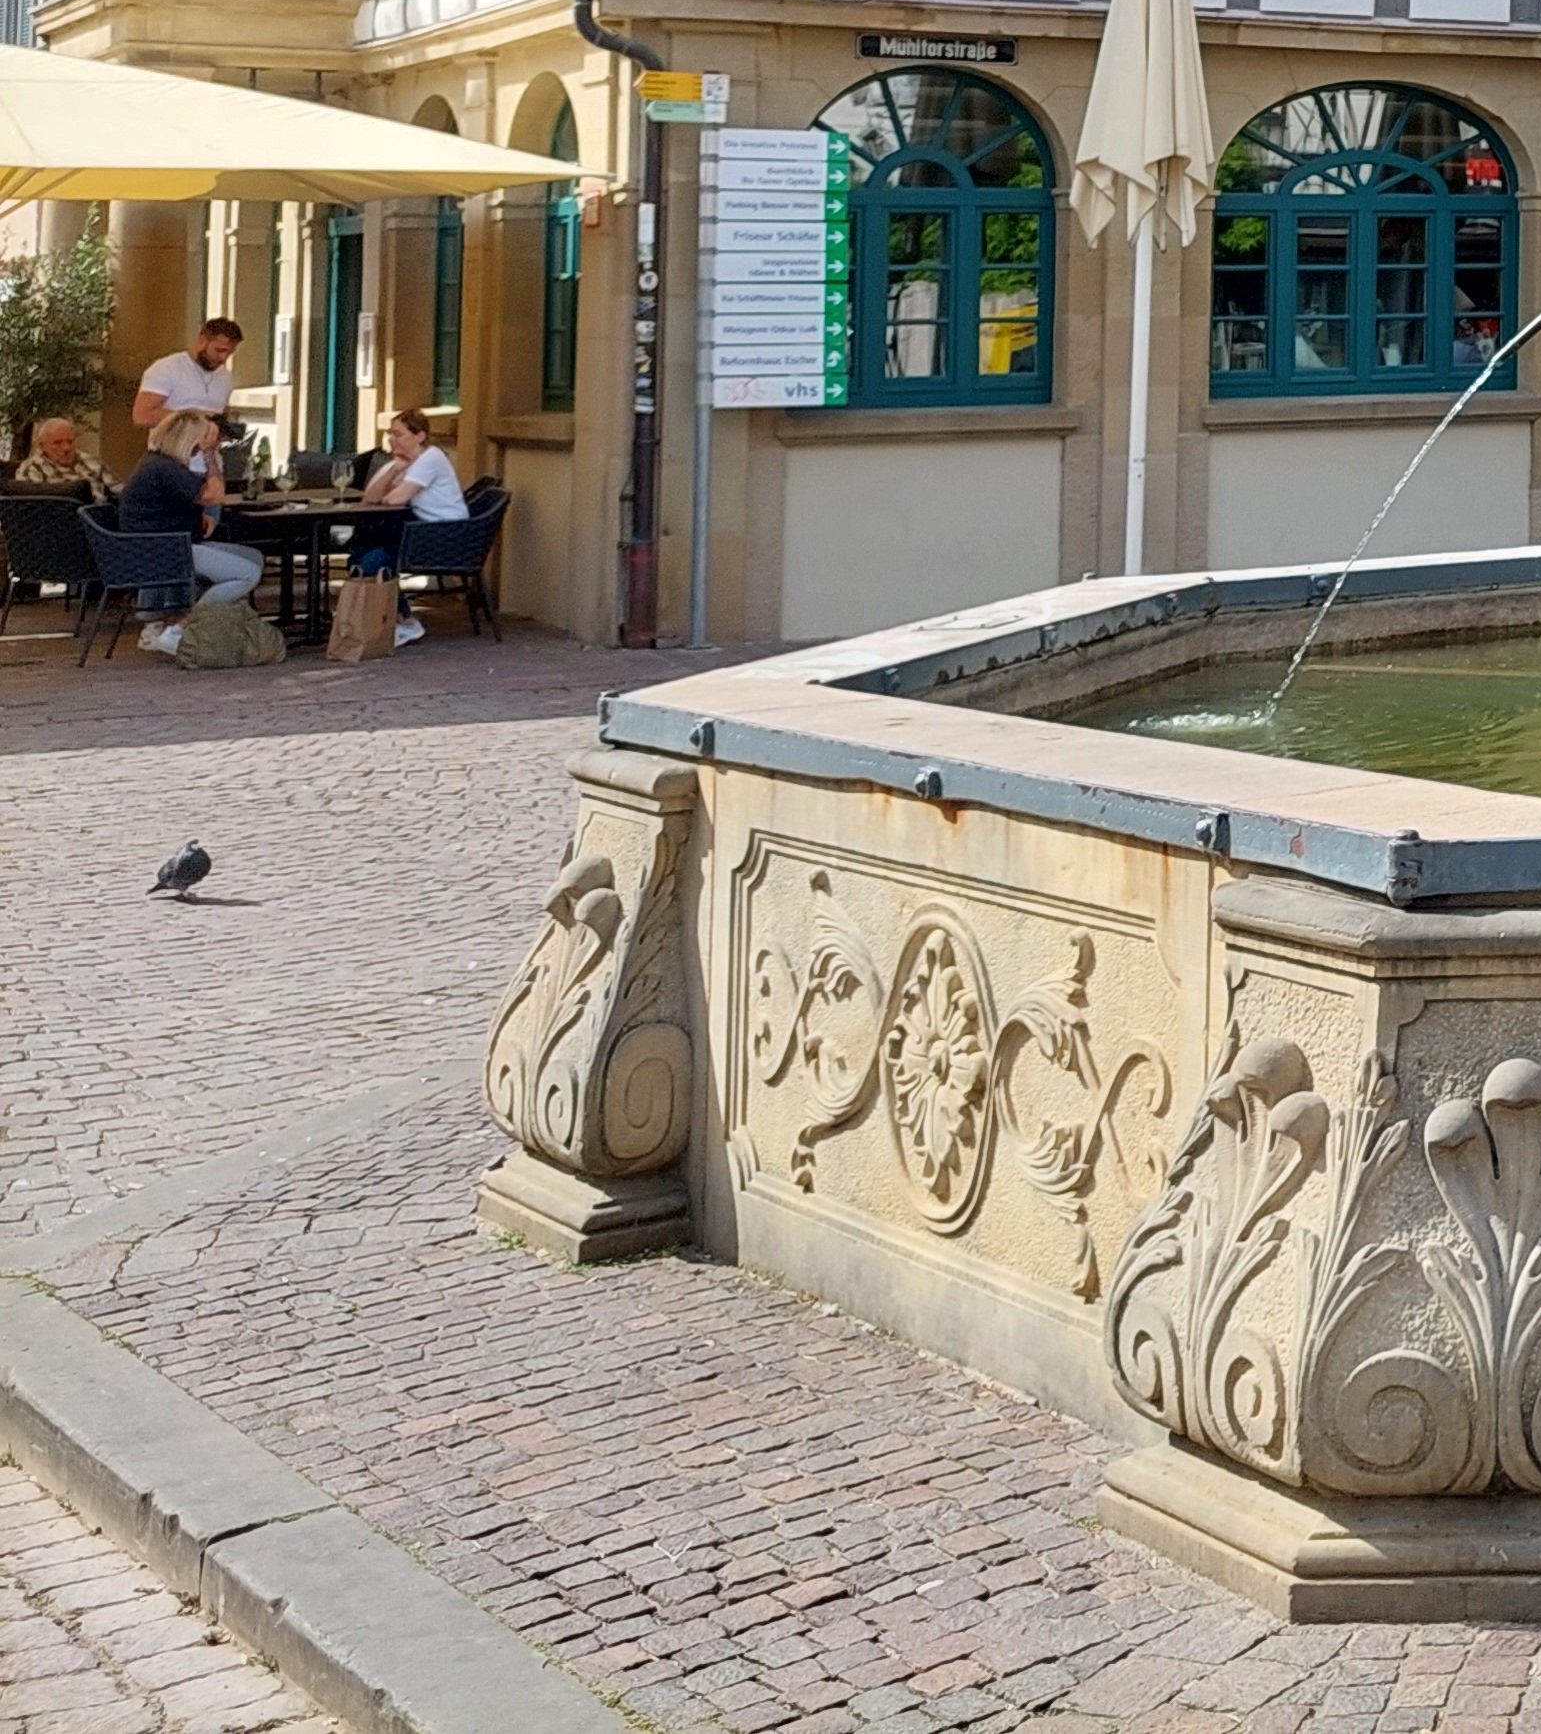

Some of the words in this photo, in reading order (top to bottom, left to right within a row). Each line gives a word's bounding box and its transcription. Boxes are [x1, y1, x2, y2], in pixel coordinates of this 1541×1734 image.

[880, 35, 997, 61] Mühltorstraße
[720, 357, 782, 366] Reformhaus
[784, 383, 819, 397] vhs
